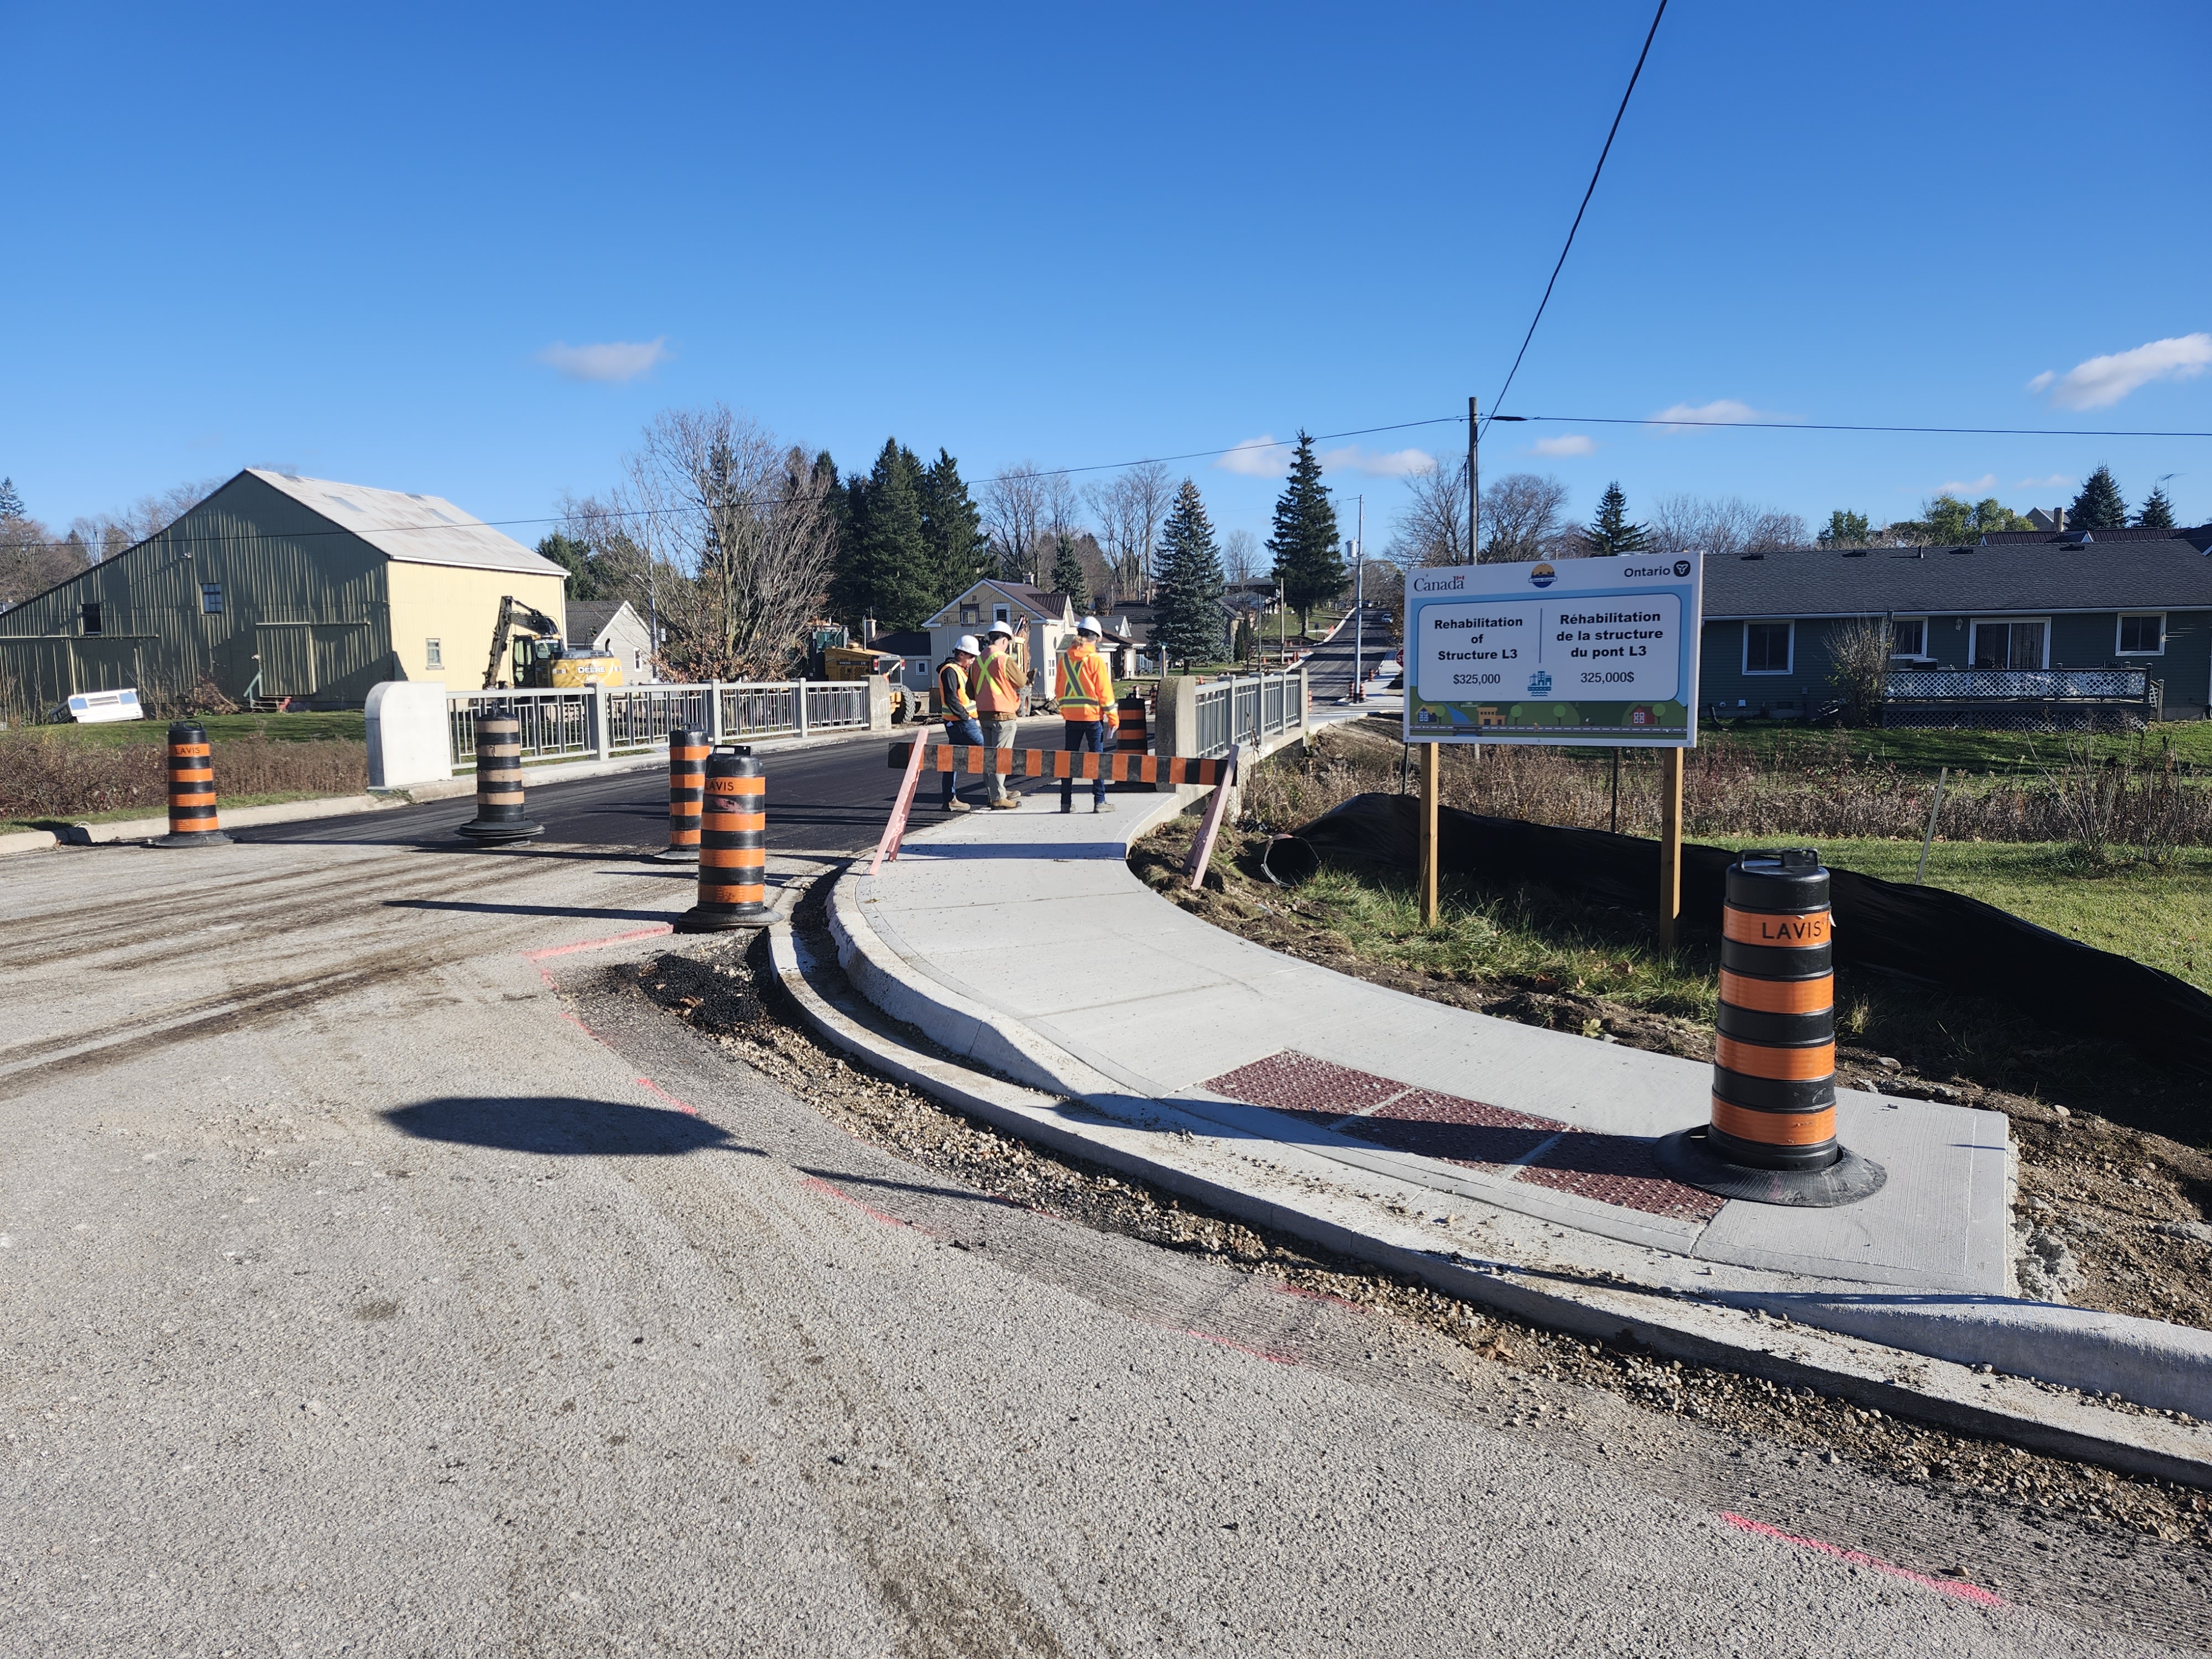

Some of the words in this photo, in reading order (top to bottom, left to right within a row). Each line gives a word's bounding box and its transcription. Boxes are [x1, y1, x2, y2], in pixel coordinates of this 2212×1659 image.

[1624, 566, 1671, 577] Ontario
[1413, 576, 1465, 592] Canada
[1434, 617, 1523, 629] Rehabilitation
[1560, 612, 1661, 625] Réhabilitation
[1470, 634, 1484, 644] of
[1556, 631, 1573, 641] de
[1578, 630, 1590, 641] la
[1594, 629, 1663, 640] structure
[1438, 650, 1498, 660] Structure
[1501, 649, 1517, 659] L3
[1571, 648, 1588, 658] du
[1592, 646, 1625, 660] pont
[1629, 645, 1647, 656] L3
[1453, 674, 1500, 685] $325,000
[1580, 671, 1635, 684] 325,000$
[175, 747, 200, 755] LAVIS
[1762, 921, 1822, 940] LAVIS
